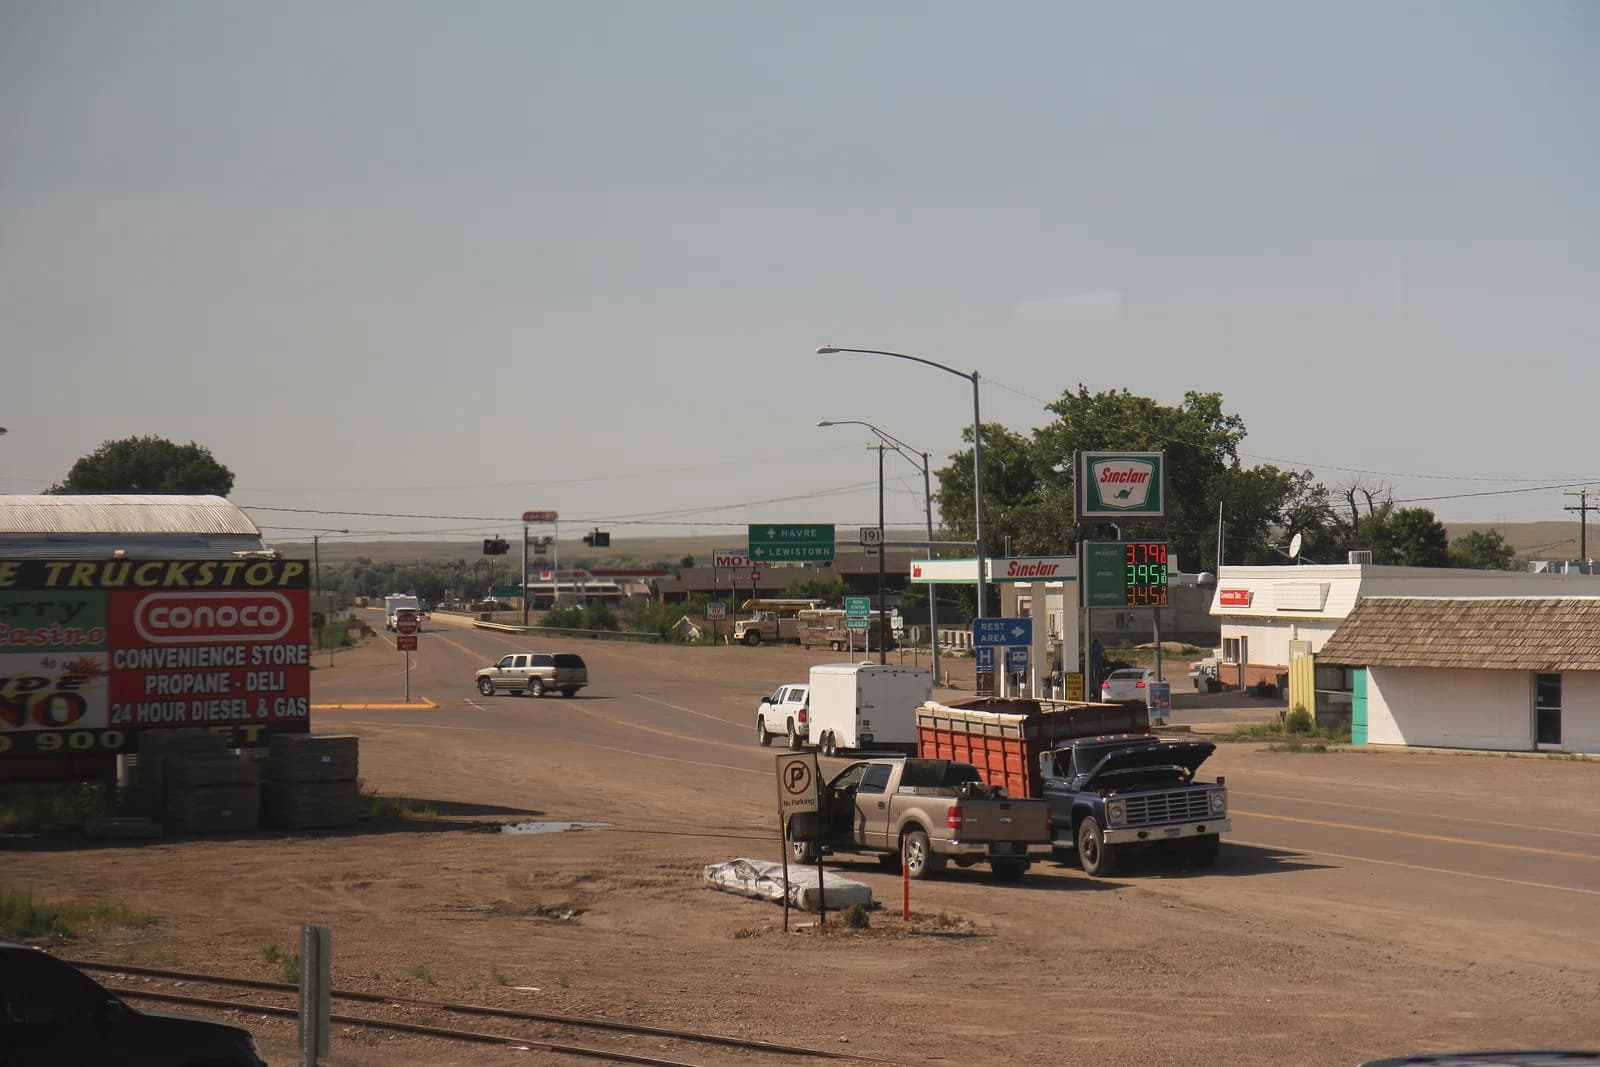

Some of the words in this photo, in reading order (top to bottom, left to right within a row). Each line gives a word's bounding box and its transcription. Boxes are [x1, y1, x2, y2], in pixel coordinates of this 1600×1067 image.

[1100, 467, 1149, 483] Sinclair
[781, 528, 817, 537] HAVRE
[863, 531, 880, 542] 191
[769, 548, 830, 556] LEWISTOWN
[716, 556, 775, 567] MOT
[1008, 560, 1059, 577] Sinclair
[44, 561, 305, 588] TRUCKSTOP
[150, 605, 281, 629] conoco
[981, 622, 1006, 631] REST
[981, 634, 1006, 643] AREA
[113, 645, 247, 670] CONVENIENCE
[251, 643, 308, 665] STORE
[979, 649, 991, 664] H
[1201, 665, 1217, 676] ICE
[145, 672, 231, 696] PROPANE
[246, 670, 286, 692] DELI
[111, 702, 133, 724] 24
[137, 700, 187, 723] HOUR
[191, 697, 251, 721] DIESEL
[256, 697, 268, 718] &
[273, 696, 308, 718] GAS
[36, 729, 126, 751] 900
[791, 798, 815, 808] Parking
